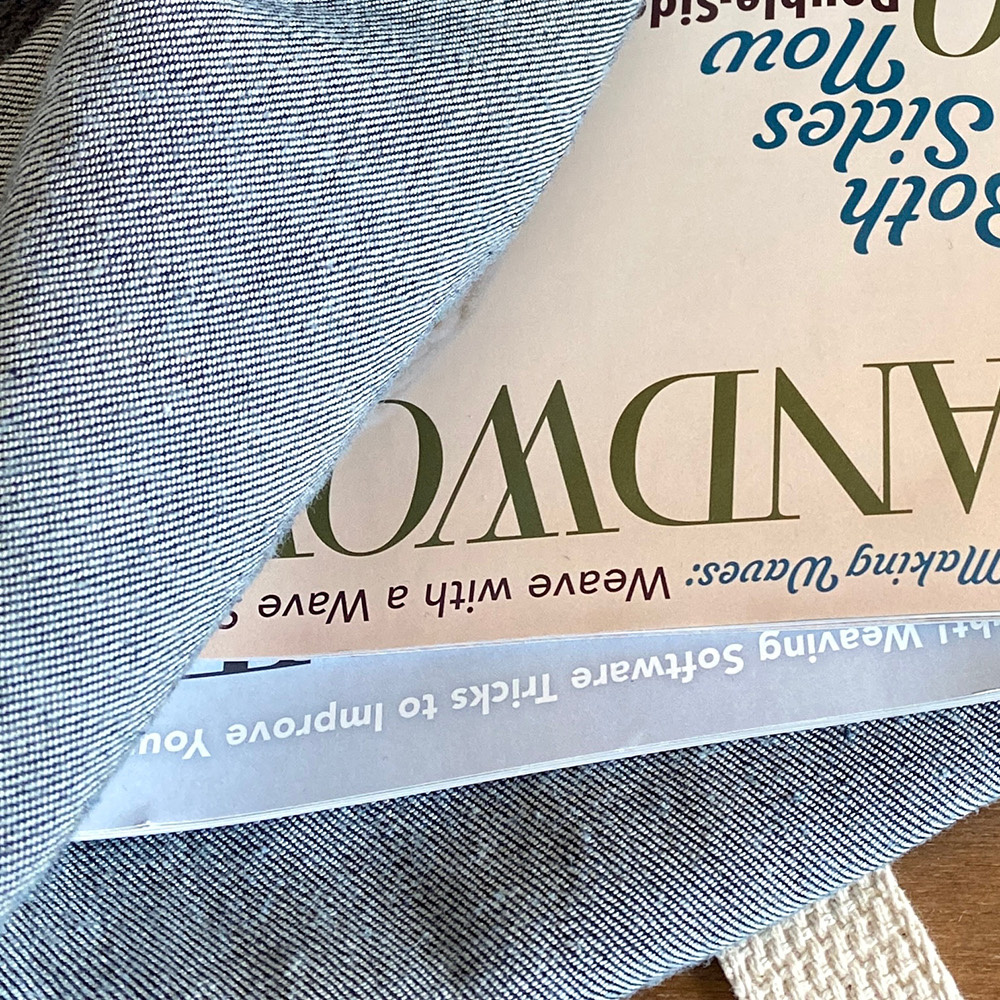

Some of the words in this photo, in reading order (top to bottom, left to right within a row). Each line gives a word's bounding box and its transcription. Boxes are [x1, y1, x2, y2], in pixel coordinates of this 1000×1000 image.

[699, 18, 905, 96] Now
[752, 94, 995, 173] Sides
[528, 566, 671, 602] Weave
[685, 554, 839, 594] Waves:
[258, 588, 370, 625] Wave
[387, 585, 409, 608] a
[425, 574, 512, 618] with
[758, 624, 924, 664] Weaving
[571, 643, 745, 690] Software
[399, 692, 438, 720] to
[451, 672, 558, 716] Tricks
[132, 728, 212, 760] You
[226, 702, 383, 747] Improve
